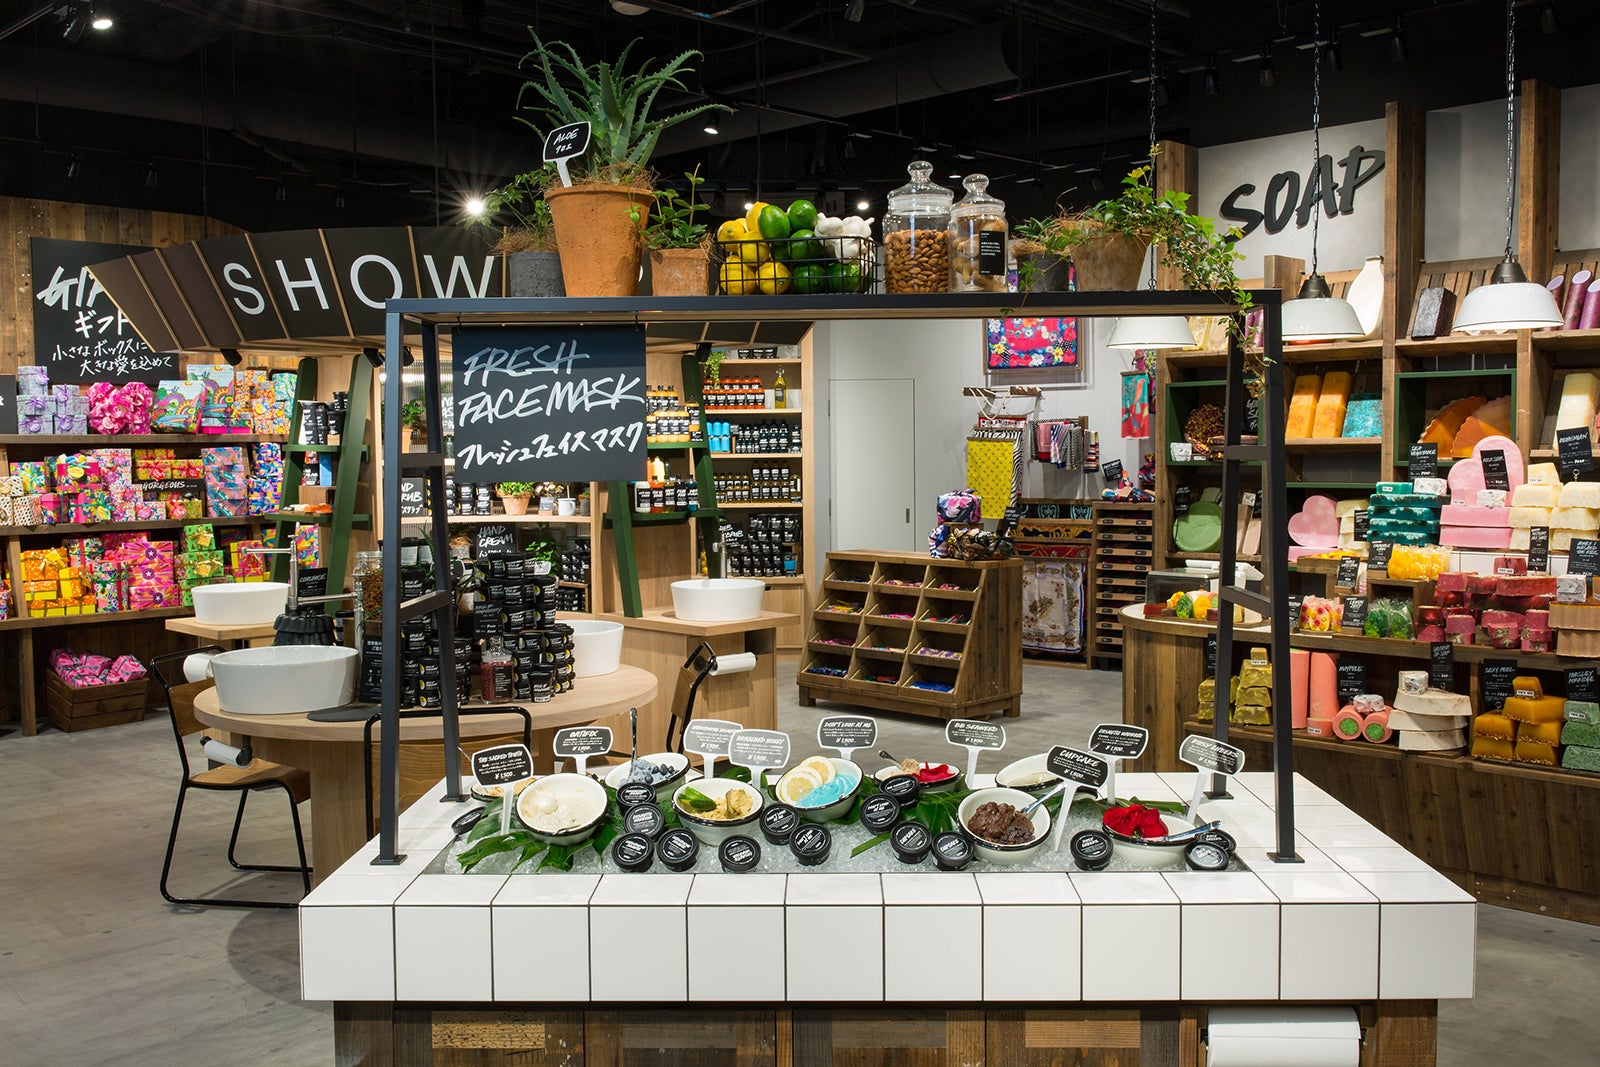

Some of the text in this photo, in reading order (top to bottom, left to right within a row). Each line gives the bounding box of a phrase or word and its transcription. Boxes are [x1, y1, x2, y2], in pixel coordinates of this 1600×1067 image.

[553, 128, 579, 145] ALOE
[1219, 145, 1385, 243] SOAP
[74, 310, 129, 338] ギフト
[79, 355, 172, 377] 大きな愛を込めて
[463, 340, 590, 387] FRESH
[143, 481, 186, 491] GORGEOUS
[479, 525, 506, 538] HAND
[479, 534, 513, 547] CREAM
[1059, 749, 1100, 767] CUPCAKE
